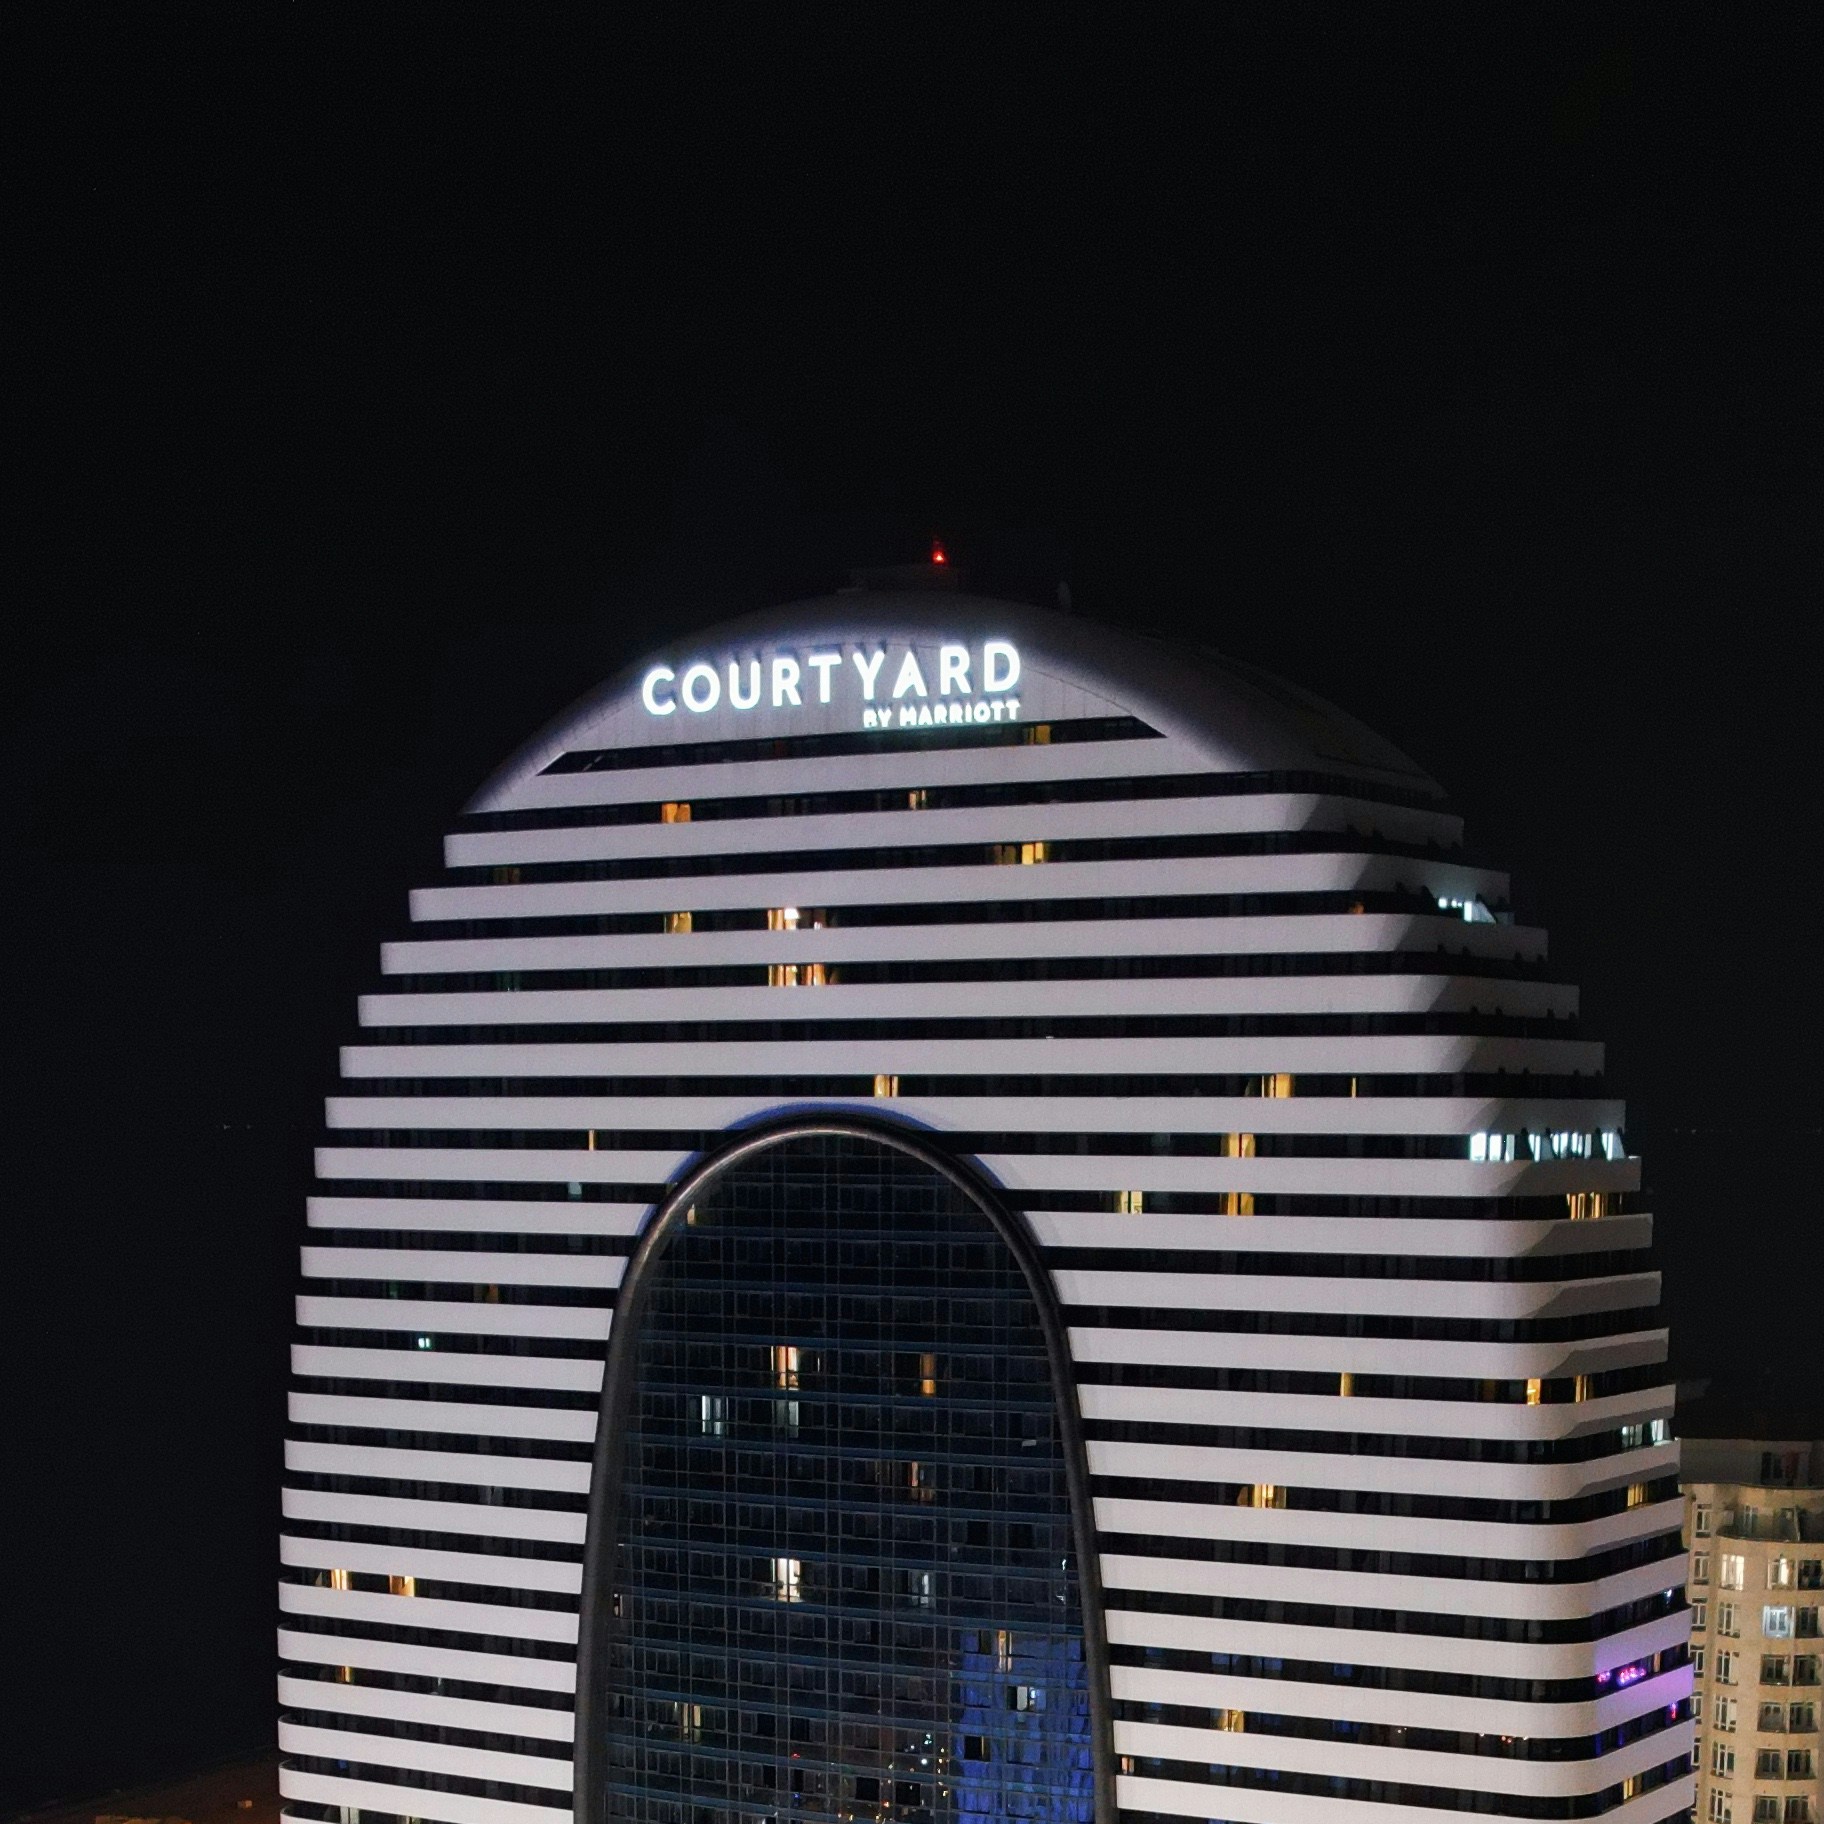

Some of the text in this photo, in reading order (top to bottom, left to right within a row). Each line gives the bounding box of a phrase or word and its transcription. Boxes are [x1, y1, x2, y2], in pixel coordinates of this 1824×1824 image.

[641, 641, 1021, 716] COURTYARD
[862, 699, 1021, 728] BY MARRIOTT
